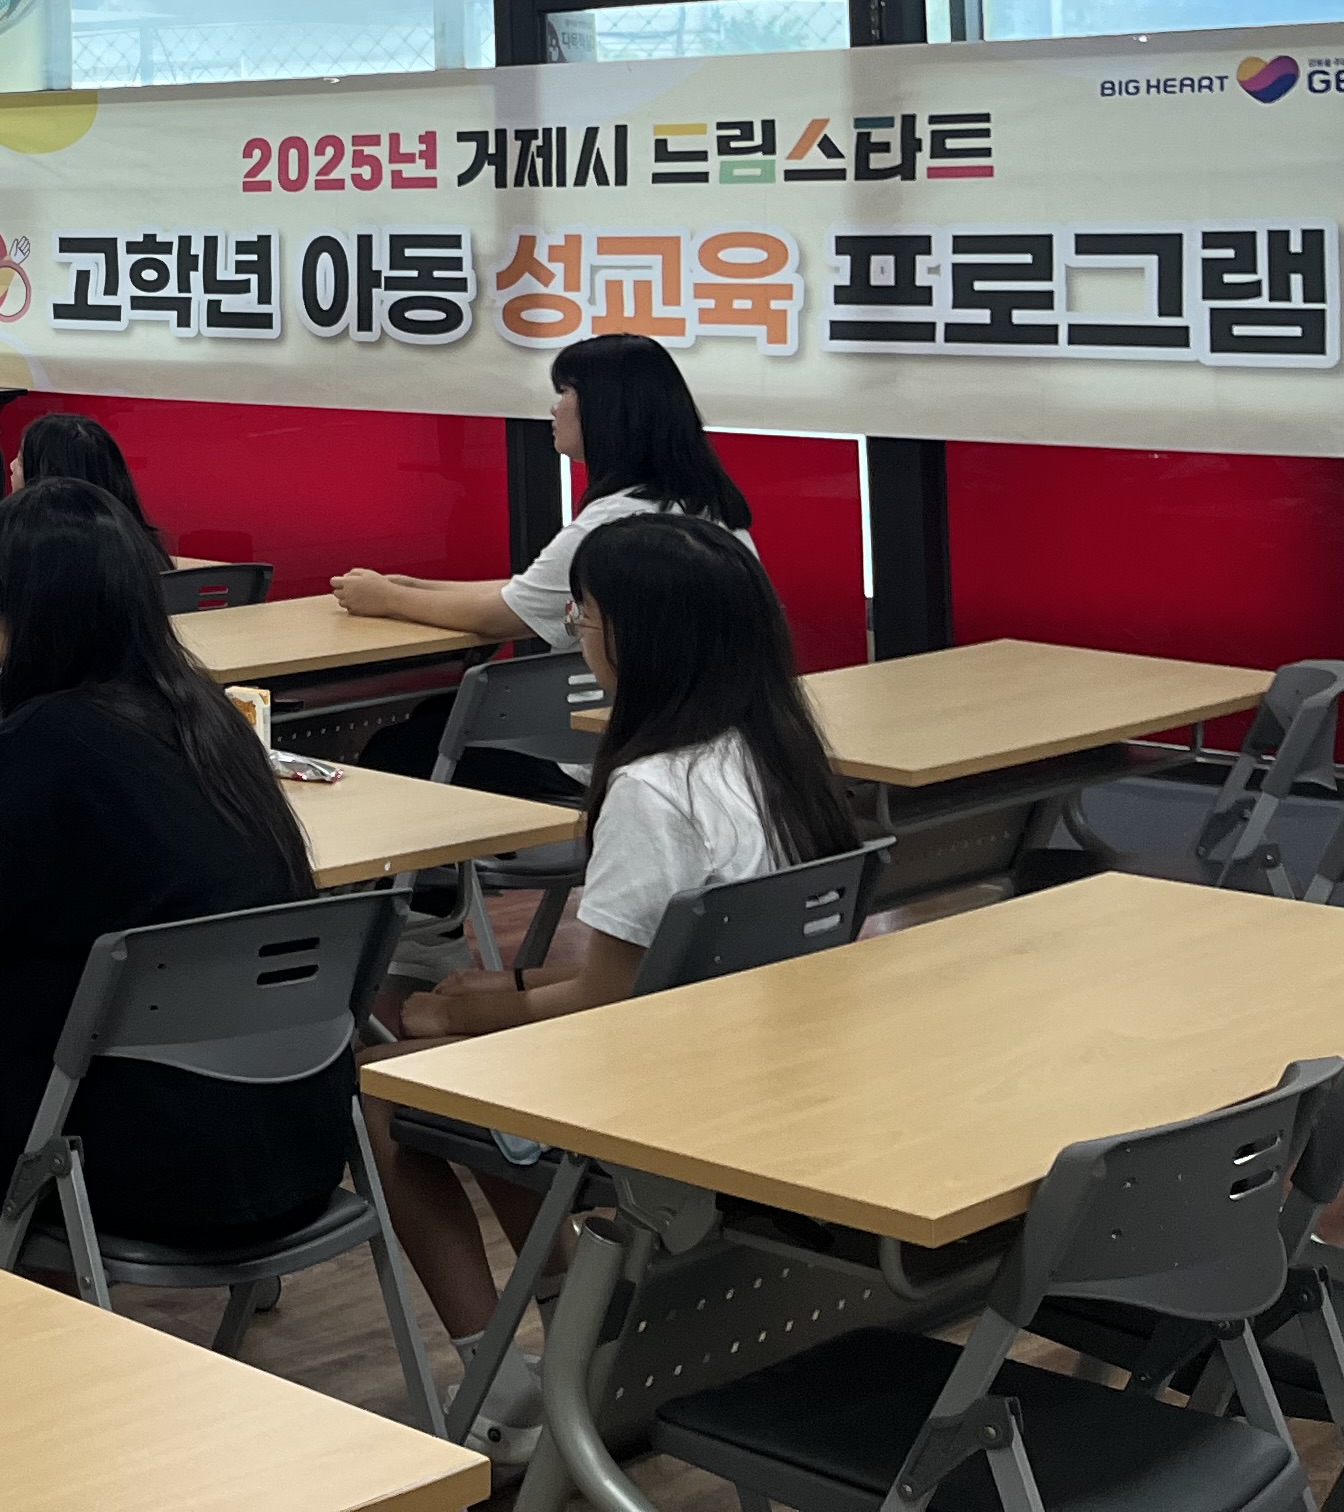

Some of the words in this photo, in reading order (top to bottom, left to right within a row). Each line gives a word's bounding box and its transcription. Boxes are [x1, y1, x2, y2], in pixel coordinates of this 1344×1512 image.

[1100, 80, 1140, 97] BIG
[1146, 76, 1229, 94] HEART
[242, 131, 437, 192] 2025년
[456, 124, 628, 188] 거제시
[651, 113, 994, 184] 드림스타트
[52, 233, 274, 329] 고학년
[302, 233, 469, 335] 아동
[496, 231, 794, 345] 성교육
[828, 229, 1327, 355] 프로그램
